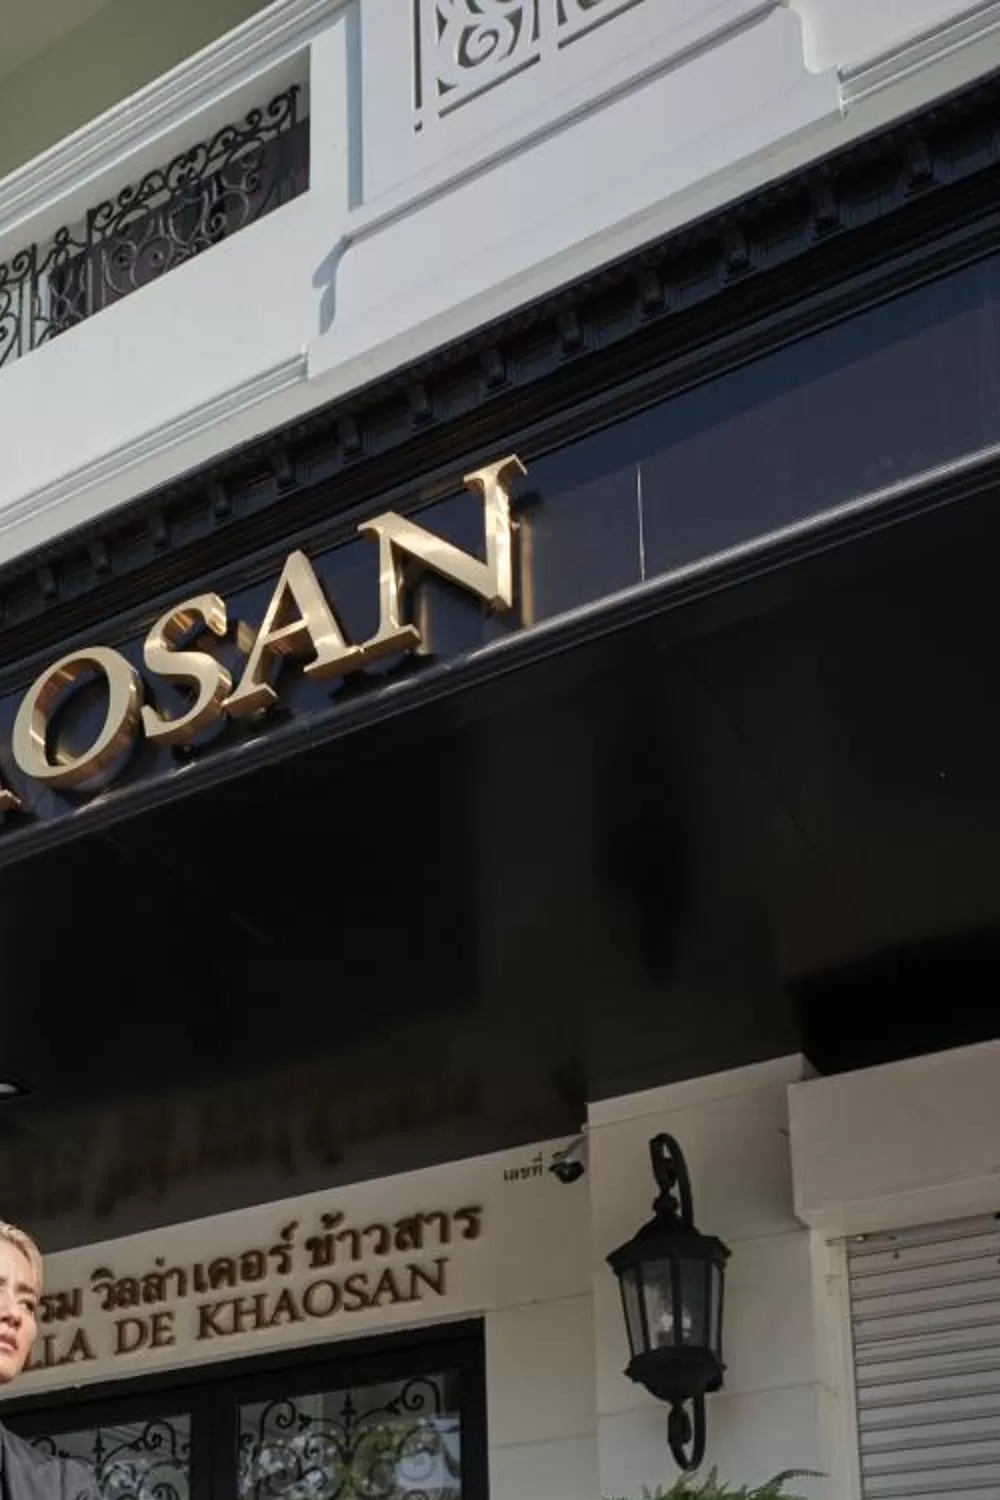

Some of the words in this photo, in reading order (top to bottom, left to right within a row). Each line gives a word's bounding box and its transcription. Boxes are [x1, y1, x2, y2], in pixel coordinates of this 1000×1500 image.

[304, 1204, 483, 1269] ข้าวสาร
[113, 1310, 176, 1356] DE
[195, 1257, 450, 1340] KHAOSAN
